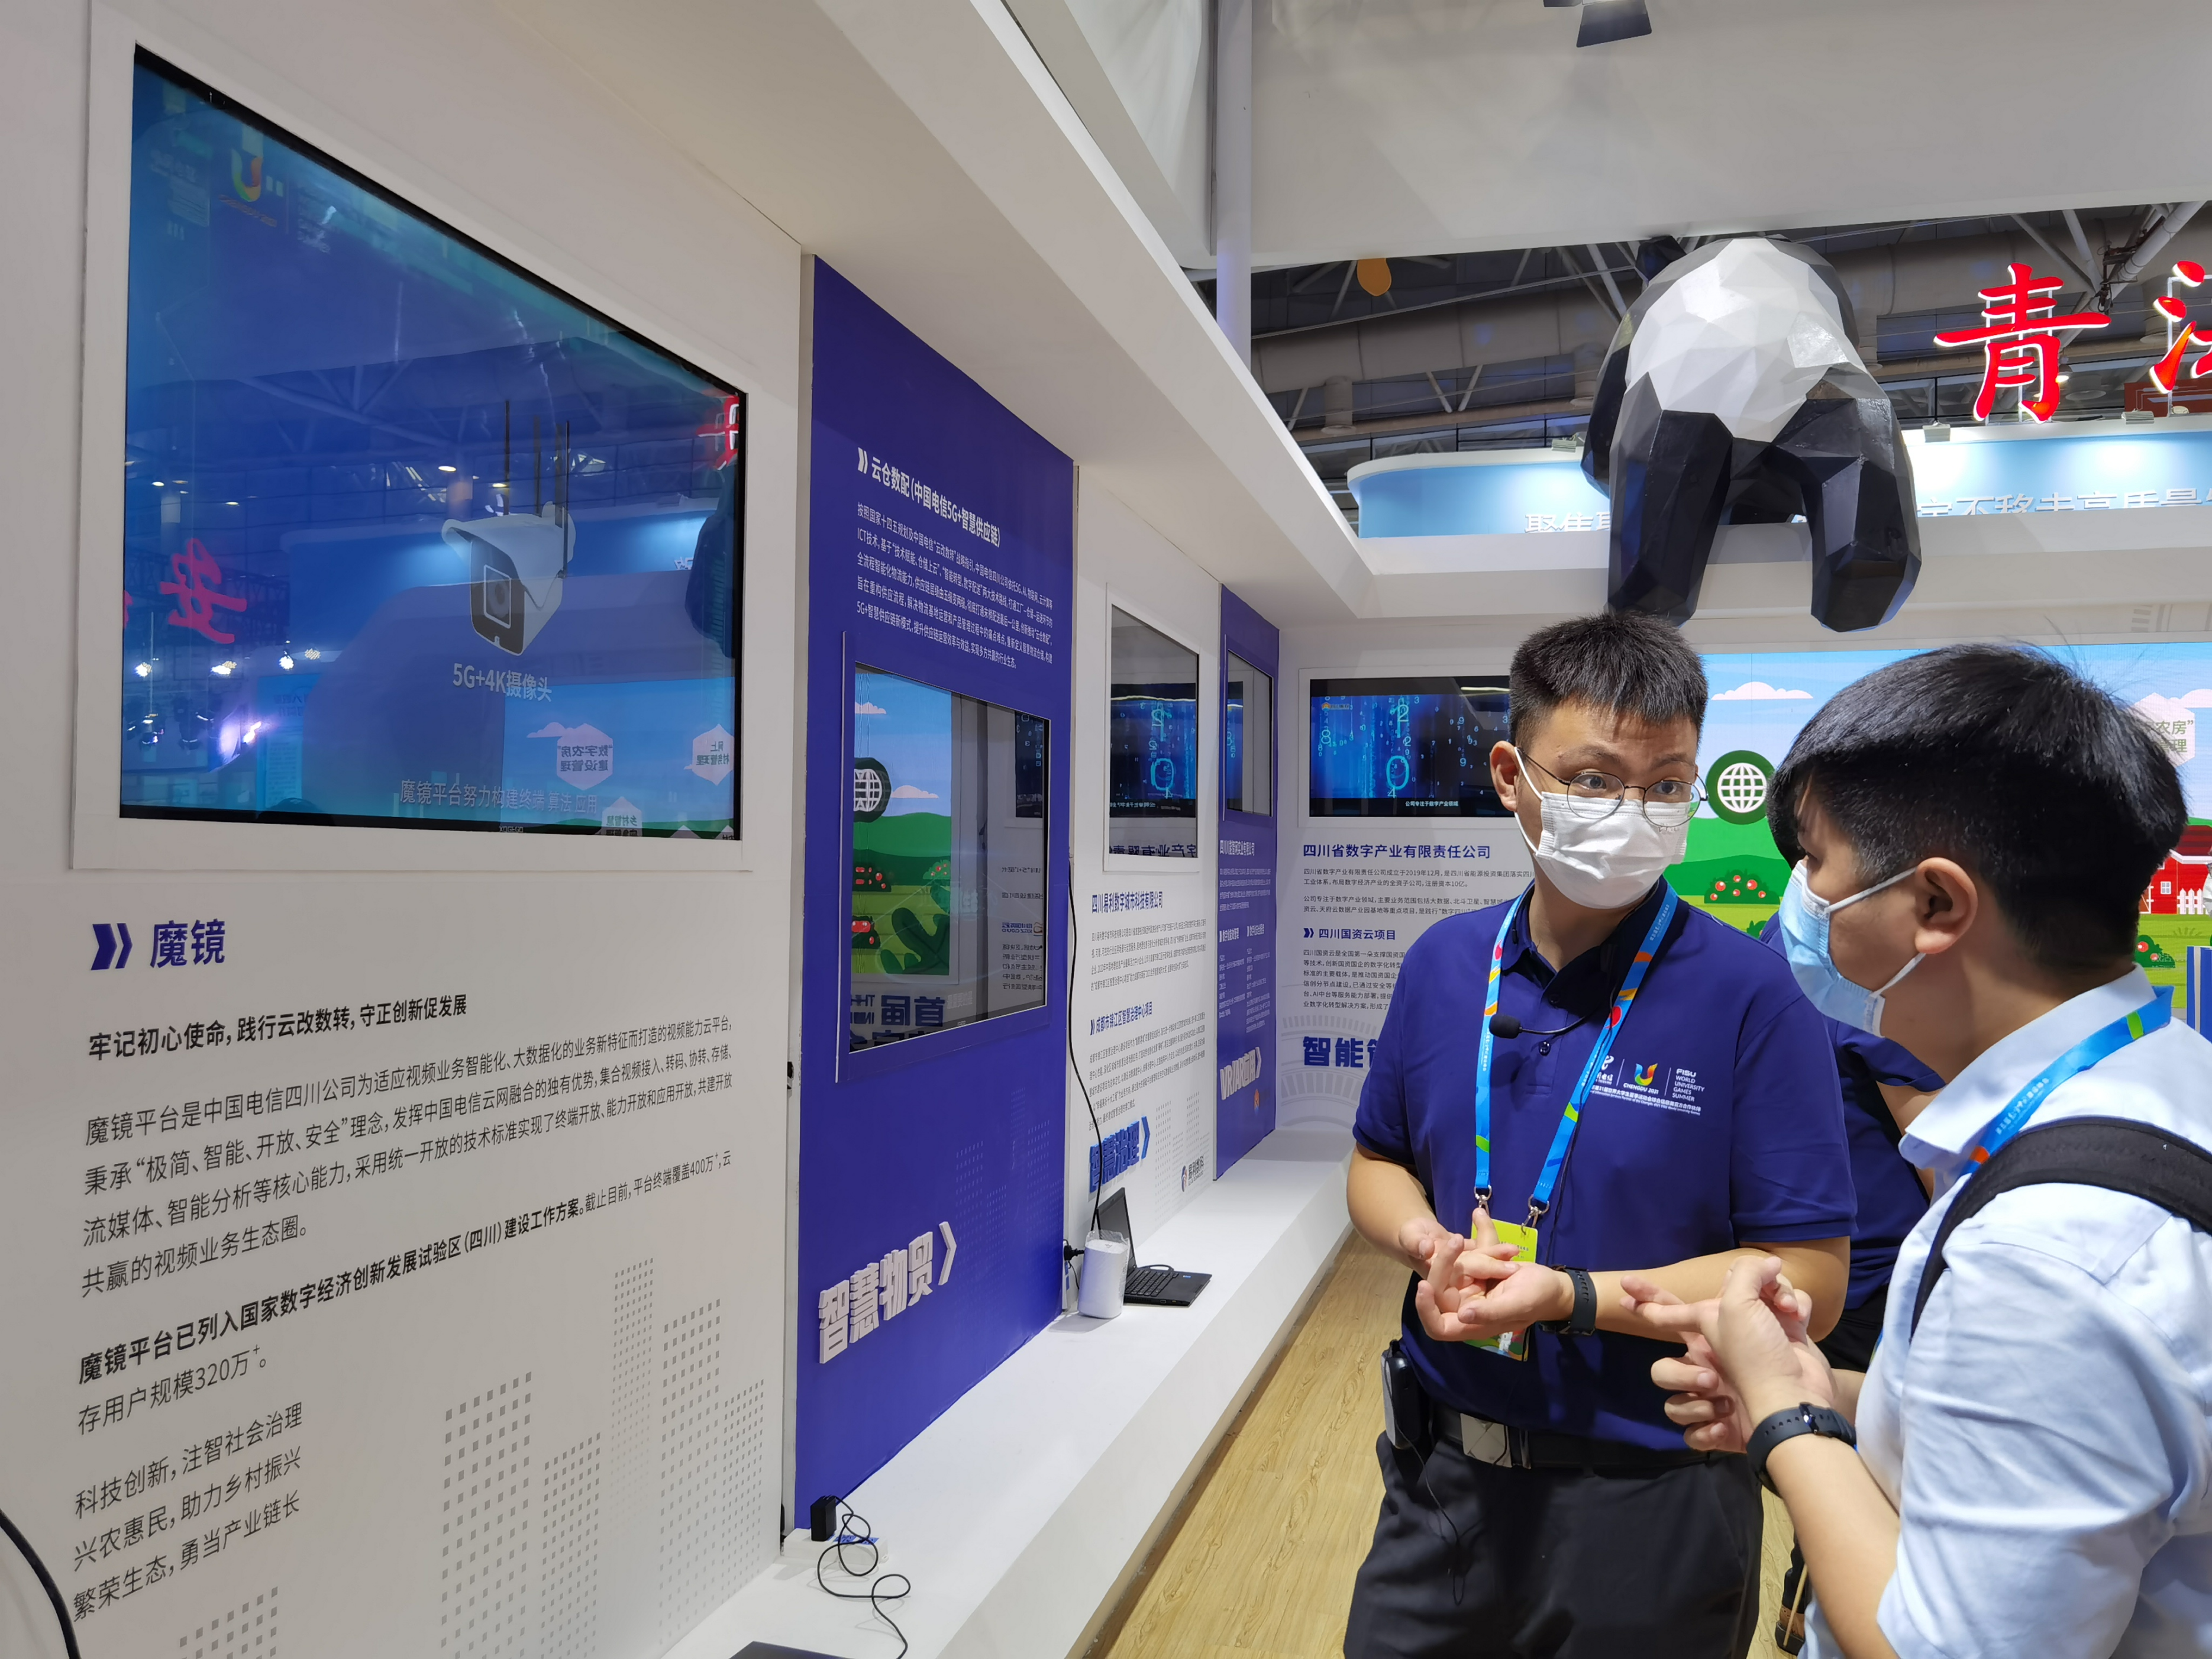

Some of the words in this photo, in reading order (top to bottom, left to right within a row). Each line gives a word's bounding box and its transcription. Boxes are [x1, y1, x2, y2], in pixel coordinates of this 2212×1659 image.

[452, 662, 553, 703] 5G+4K摄像头
[1459, 757, 1467, 767] 9
[401, 779, 545, 811] 魔镜平台努力构建终端
[547, 790, 572, 814] 算法
[575, 793, 599, 815] 应用
[1303, 844, 1491, 859] 四川省数字产业有限责任公司
[1319, 928, 1396, 941] 四川国资云项目
[150, 918, 226, 970] 魔镜
[1303, 970, 1398, 979] 标准的主要载体，是推动国资国企
[89, 994, 467, 1061] 牢记初心使命，践行云改数转，守正创新促发展
[1675, 1075, 1696, 1084] WORLD
[1676, 1068, 1697, 1078] FISU
[1623, 1083, 1648, 1093] CHENGDU
[1673, 1087, 1692, 1095] GAMES
[1674, 1081, 1705, 1092] UNIVERSITY
[1672, 1093, 1696, 1102] SUMMER
[82, 1215, 307, 1299] 共赢的视频业务生态圈。
[819, 1231, 934, 1364] 智慧物贸
[75, 1402, 303, 1519] 科技创新，注智社会治理
[73, 1446, 302, 1572] 兴农惠民，助力乡村振兴
[73, 1489, 301, 1622] 繁荣生态，勇当产业链长
